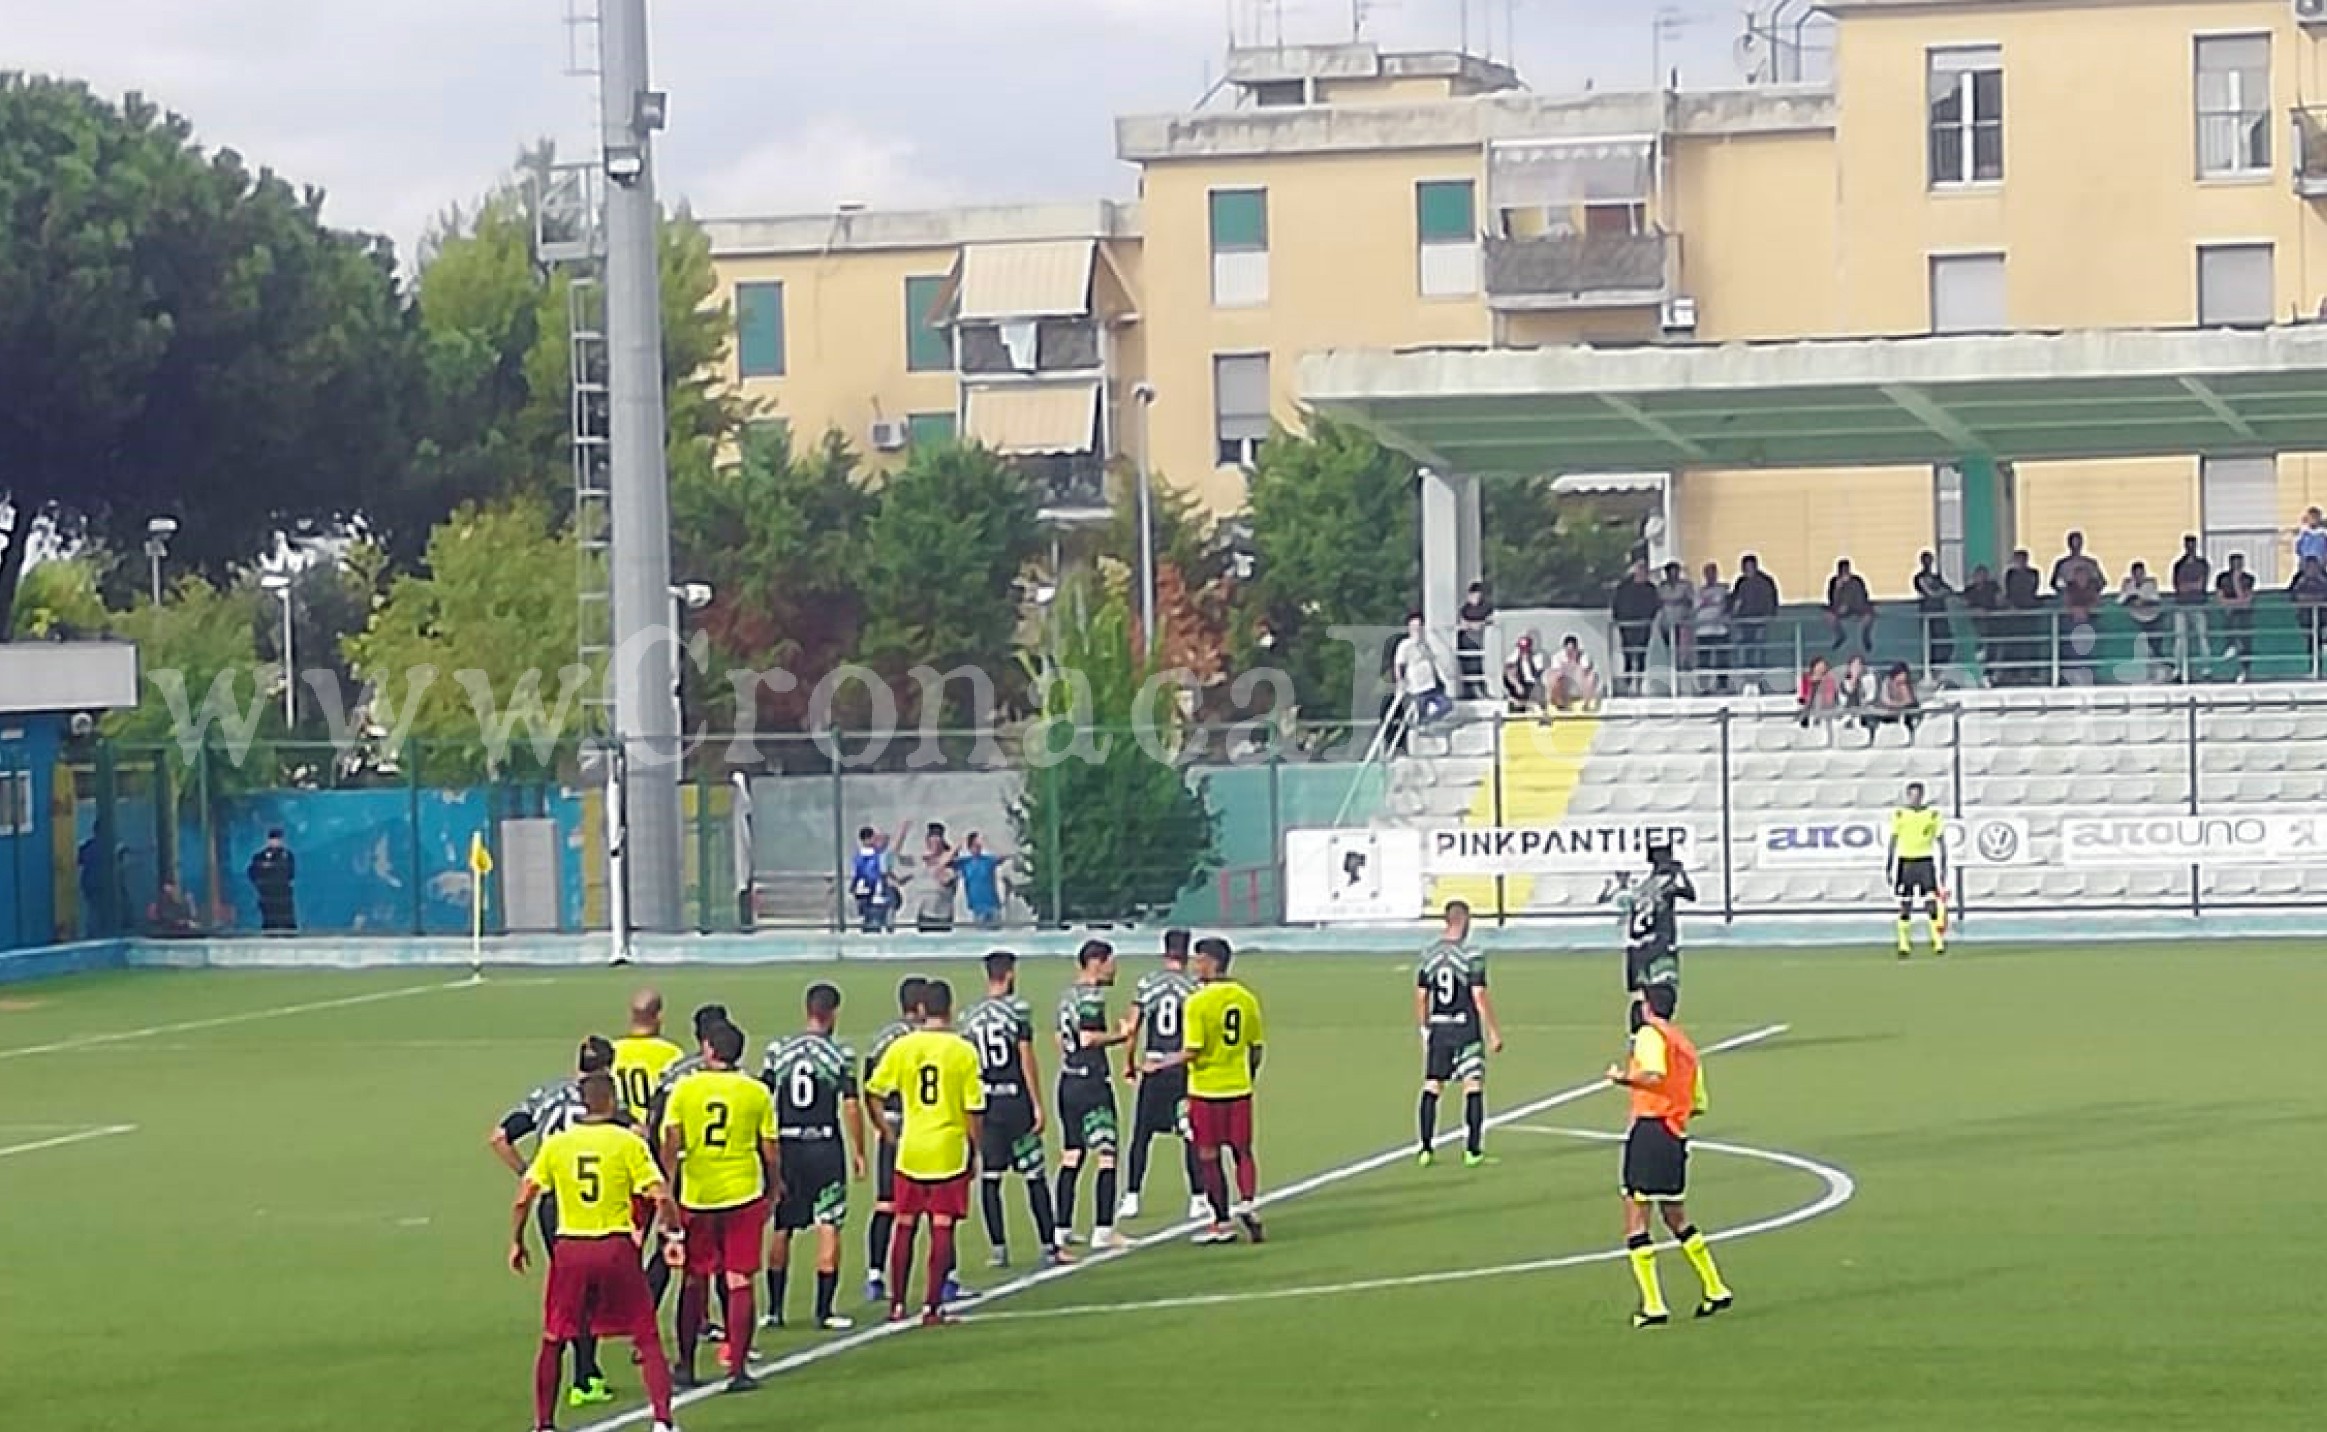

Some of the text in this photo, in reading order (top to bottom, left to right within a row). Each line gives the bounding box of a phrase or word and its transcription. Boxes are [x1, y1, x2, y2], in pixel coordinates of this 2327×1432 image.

[1436, 826, 1687, 857] PINKPANTHER
[1437, 966, 1454, 1005] 9
[1156, 998, 1177, 1036] 8
[1222, 1008, 1242, 1046] 9
[973, 1021, 1009, 1067] 15
[616, 1067, 651, 1108] 10
[789, 1059, 817, 1109] 6
[918, 1065, 940, 1105] 8
[703, 1101, 729, 1147] 2
[576, 1155, 601, 1203] 5
